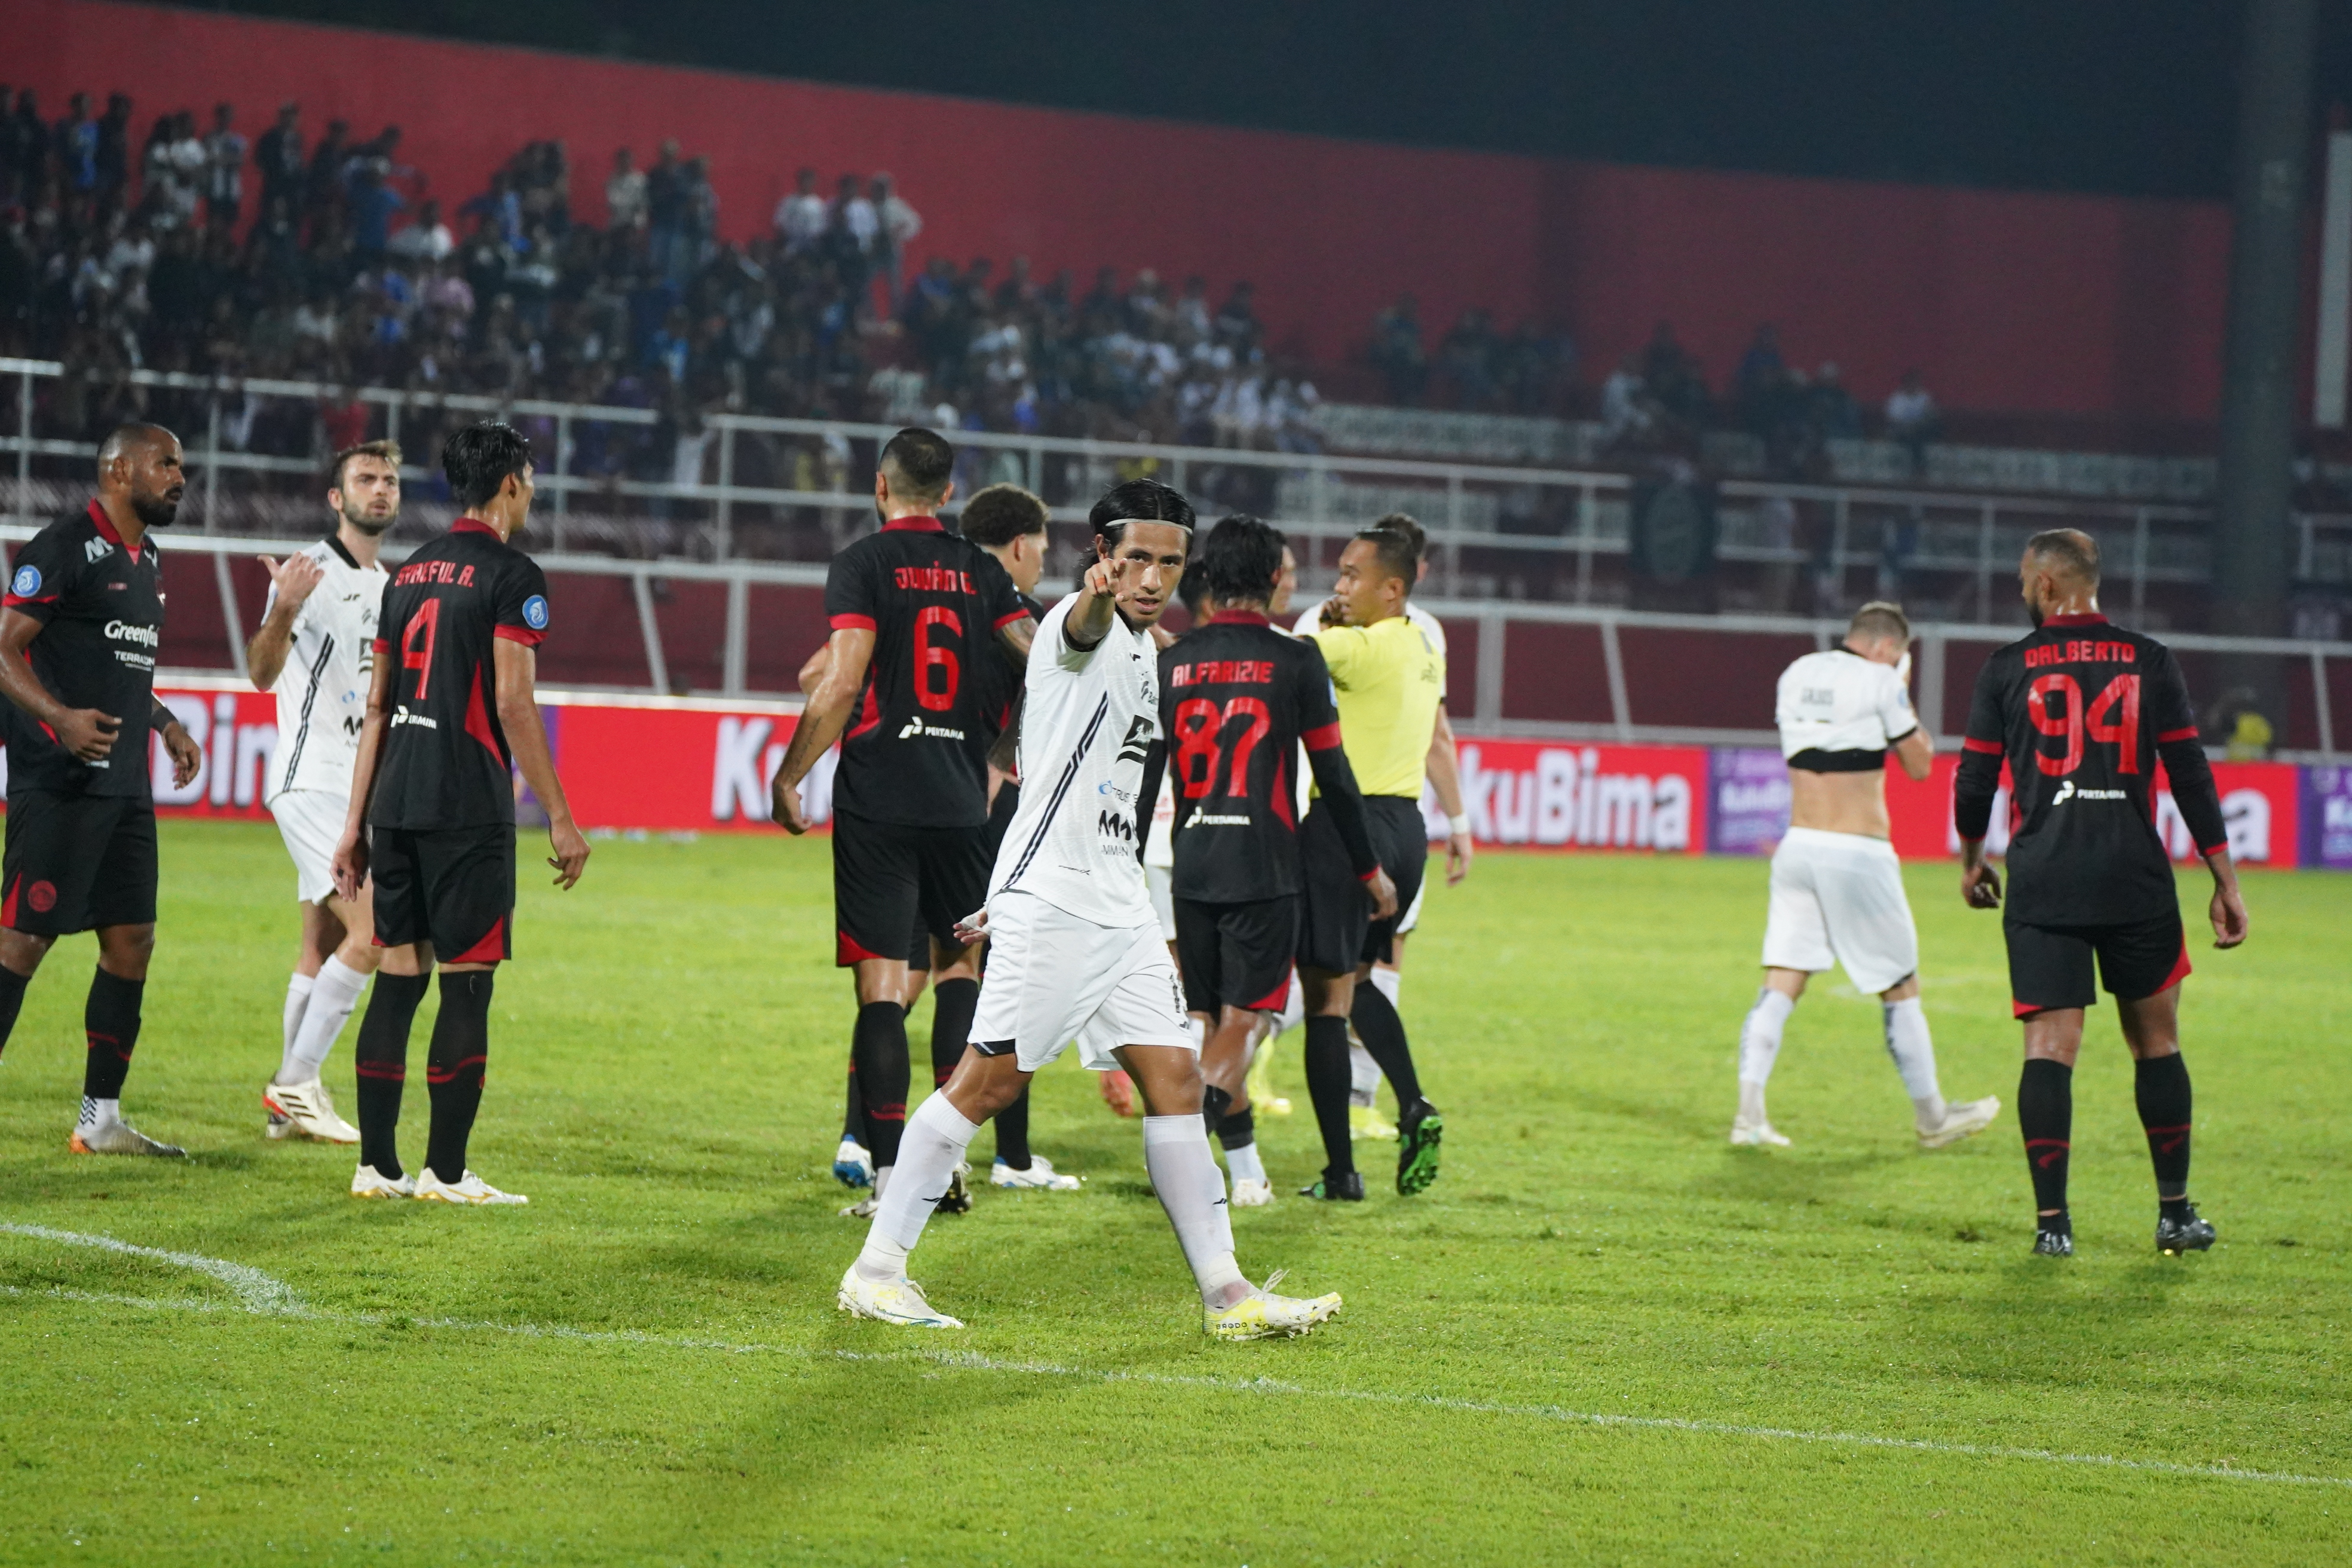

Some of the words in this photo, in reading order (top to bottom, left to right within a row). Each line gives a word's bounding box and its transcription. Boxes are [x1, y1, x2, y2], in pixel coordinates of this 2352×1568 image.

[402, 598, 440, 700] 4
[914, 606, 963, 711] 6
[1172, 660, 1275, 687] ALFARIZIE
[2025, 641, 2135, 669] DALBERTO
[1175, 697, 1271, 799] 87
[2028, 673, 2140, 776] 94
[1422, 745, 1690, 850] kuBima
